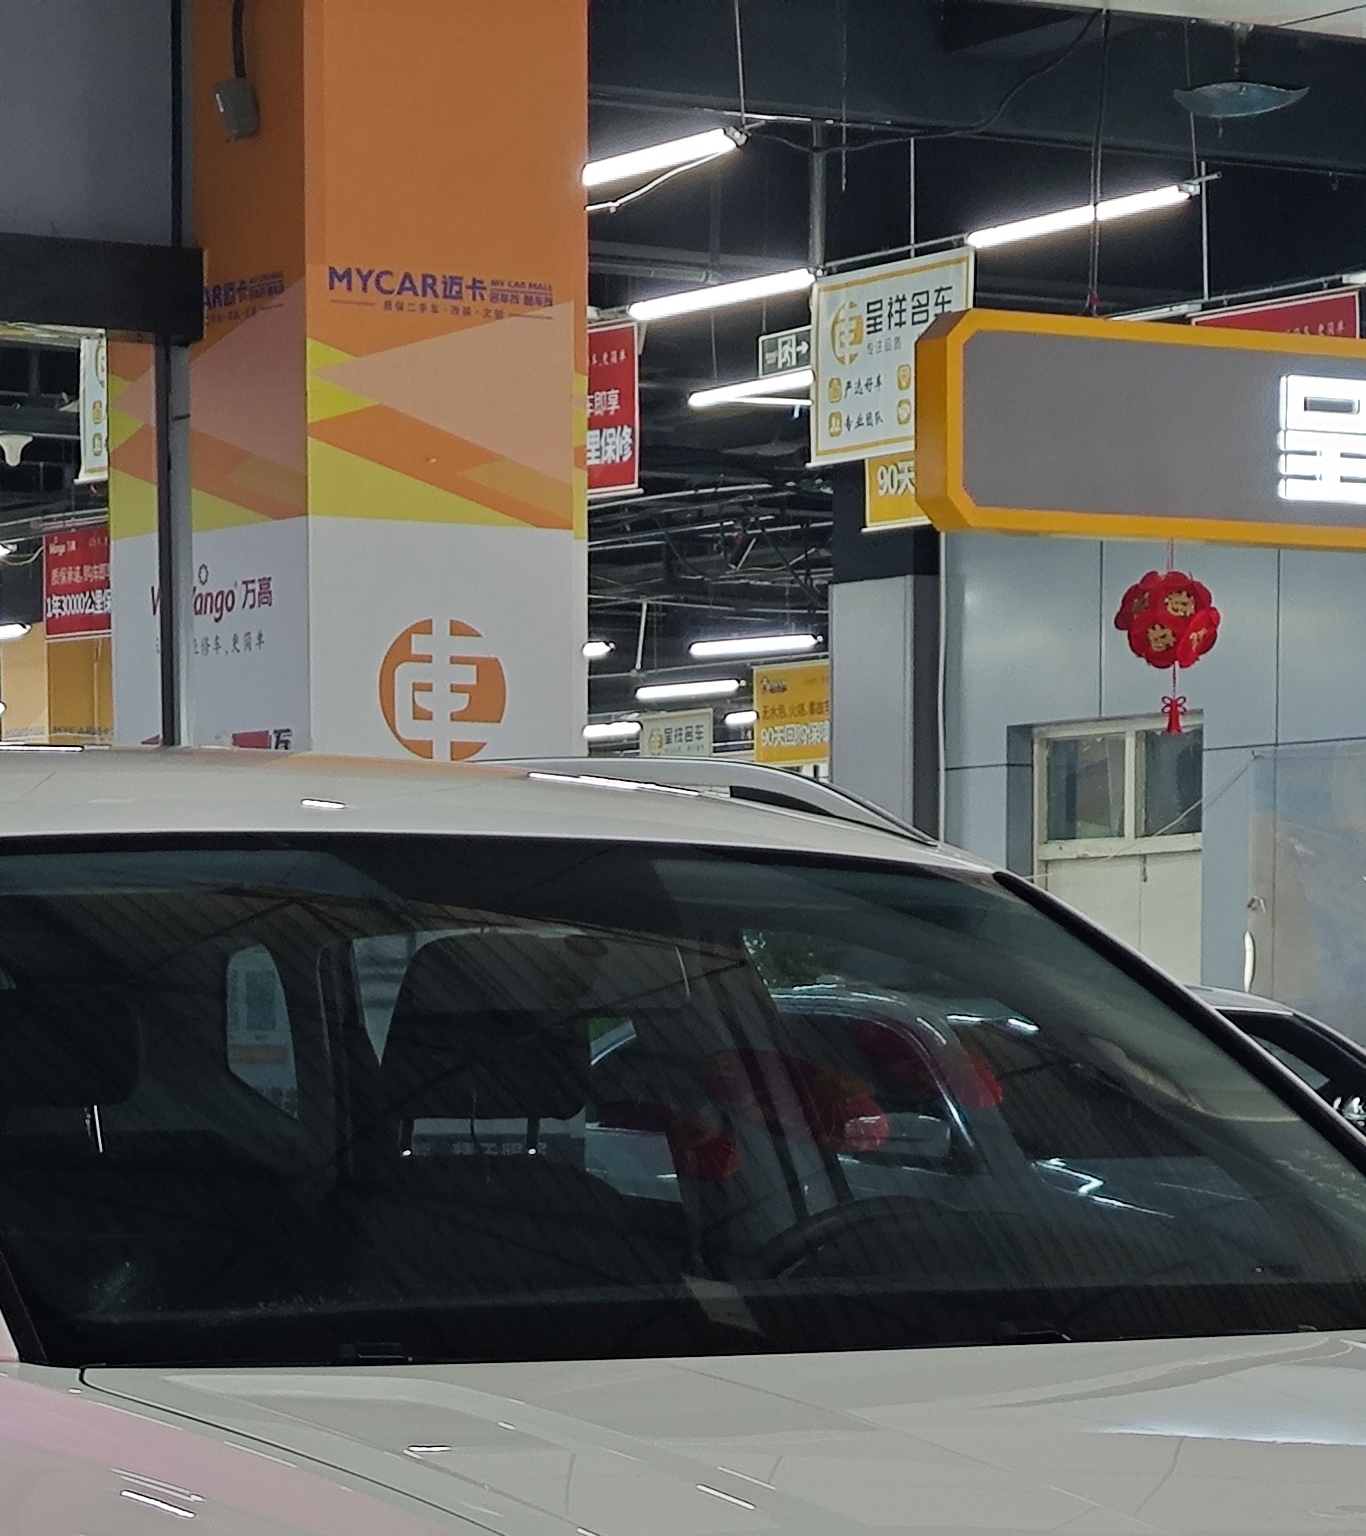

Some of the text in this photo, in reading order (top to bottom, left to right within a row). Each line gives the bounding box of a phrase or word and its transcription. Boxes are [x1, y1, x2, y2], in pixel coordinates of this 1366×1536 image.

[866, 286, 953, 335] 呈祥名车
[877, 460, 915, 496] 90天
[242, 576, 273, 610] 万高
